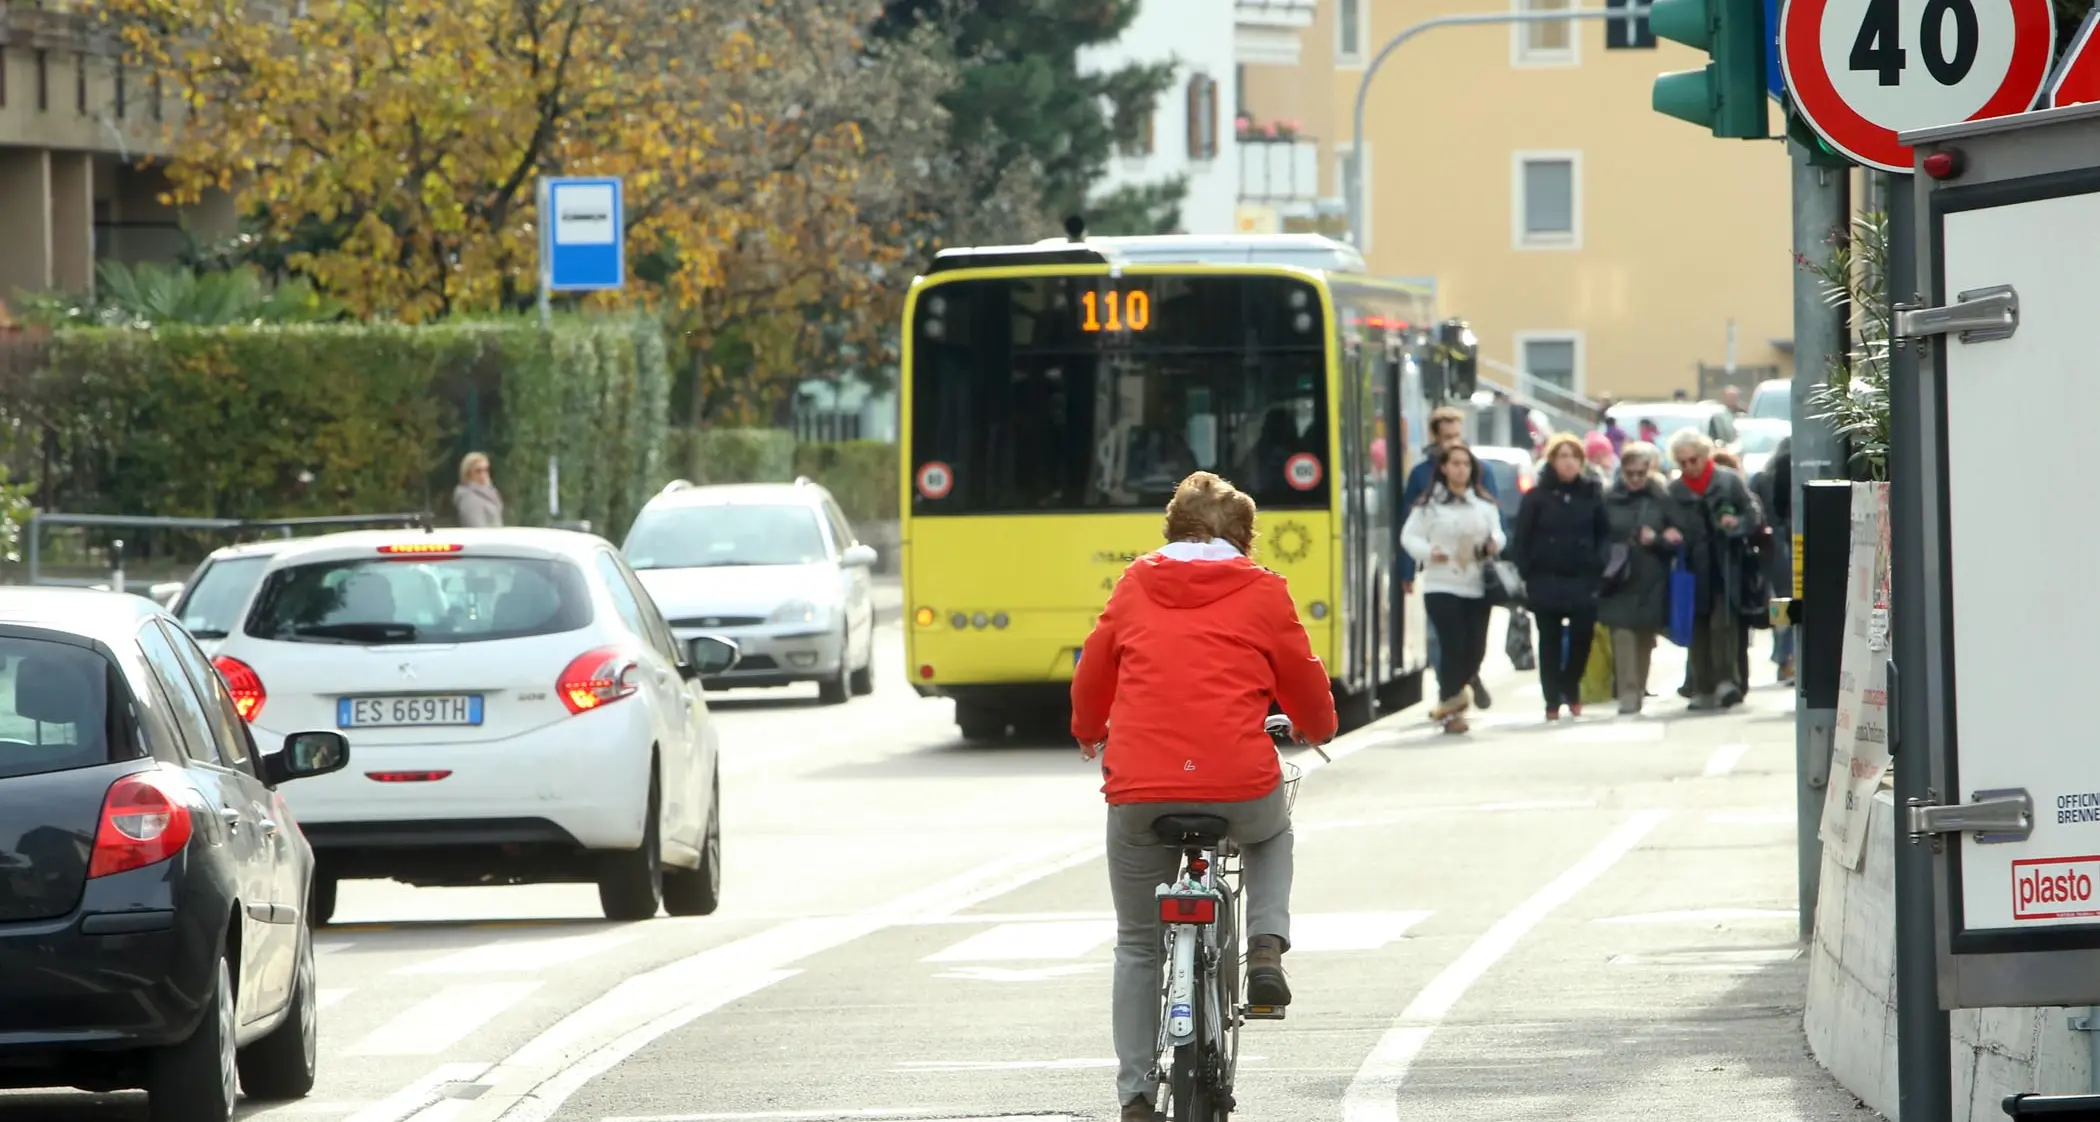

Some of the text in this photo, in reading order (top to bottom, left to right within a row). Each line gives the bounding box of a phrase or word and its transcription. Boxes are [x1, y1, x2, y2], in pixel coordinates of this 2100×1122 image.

[1849, 0, 1978, 86] 40
[1081, 289, 1150, 332] 110
[354, 698, 467, 723] ES 669TH
[2019, 868, 2092, 911] plasto
